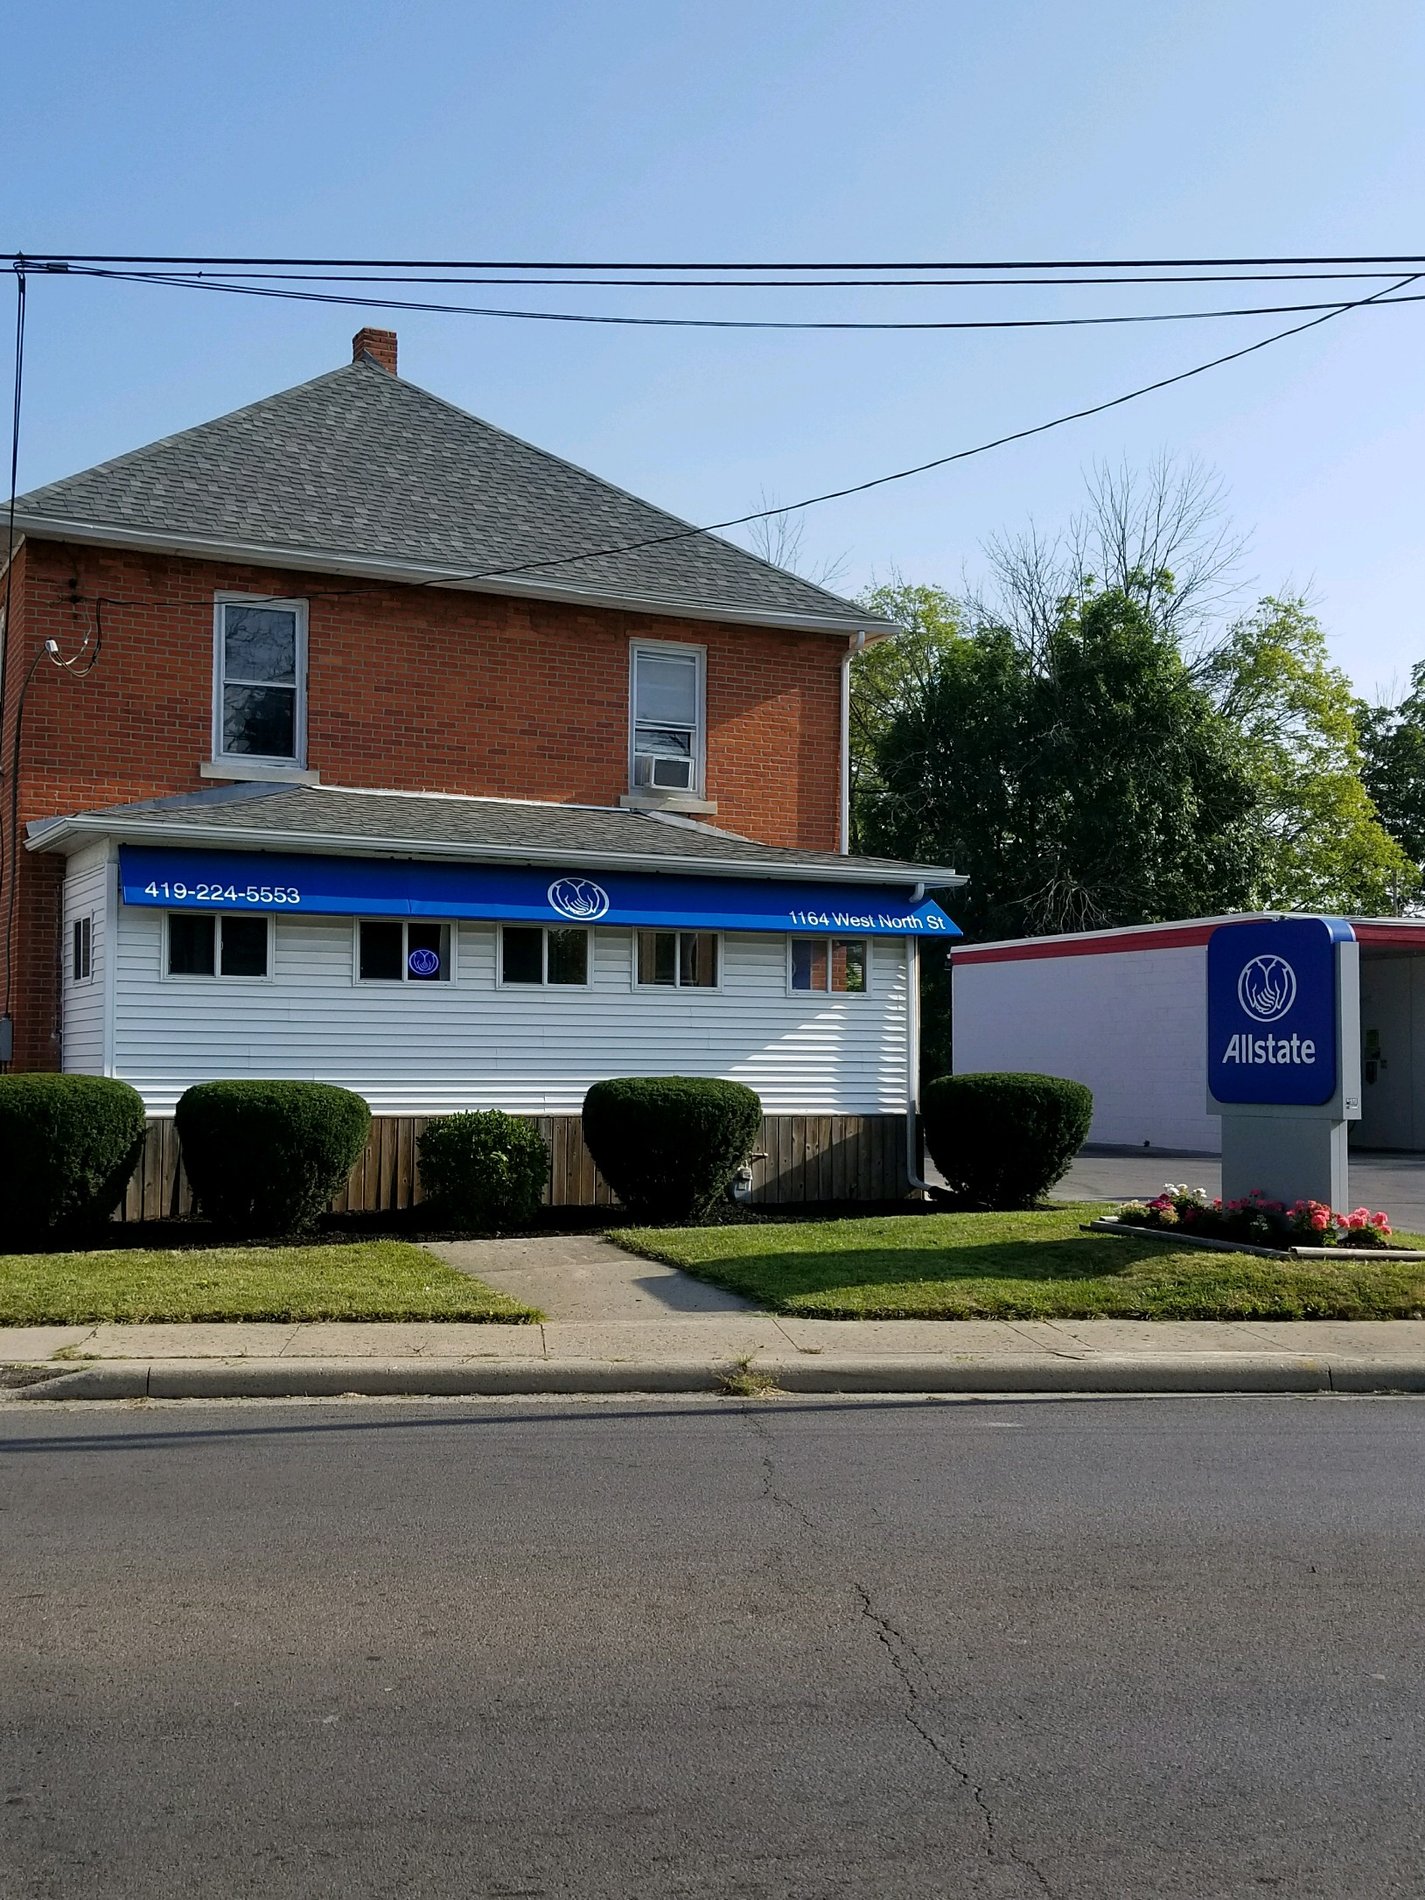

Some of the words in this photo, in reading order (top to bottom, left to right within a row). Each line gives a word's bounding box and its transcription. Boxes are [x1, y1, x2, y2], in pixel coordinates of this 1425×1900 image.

[144, 881, 301, 904] 419-224-5553
[789, 910, 830, 926] 1164
[832, 912, 876, 928] West
[878, 914, 923, 930] North
[927, 915, 946, 930] St
[1222, 1033, 1316, 1064] Allstate
